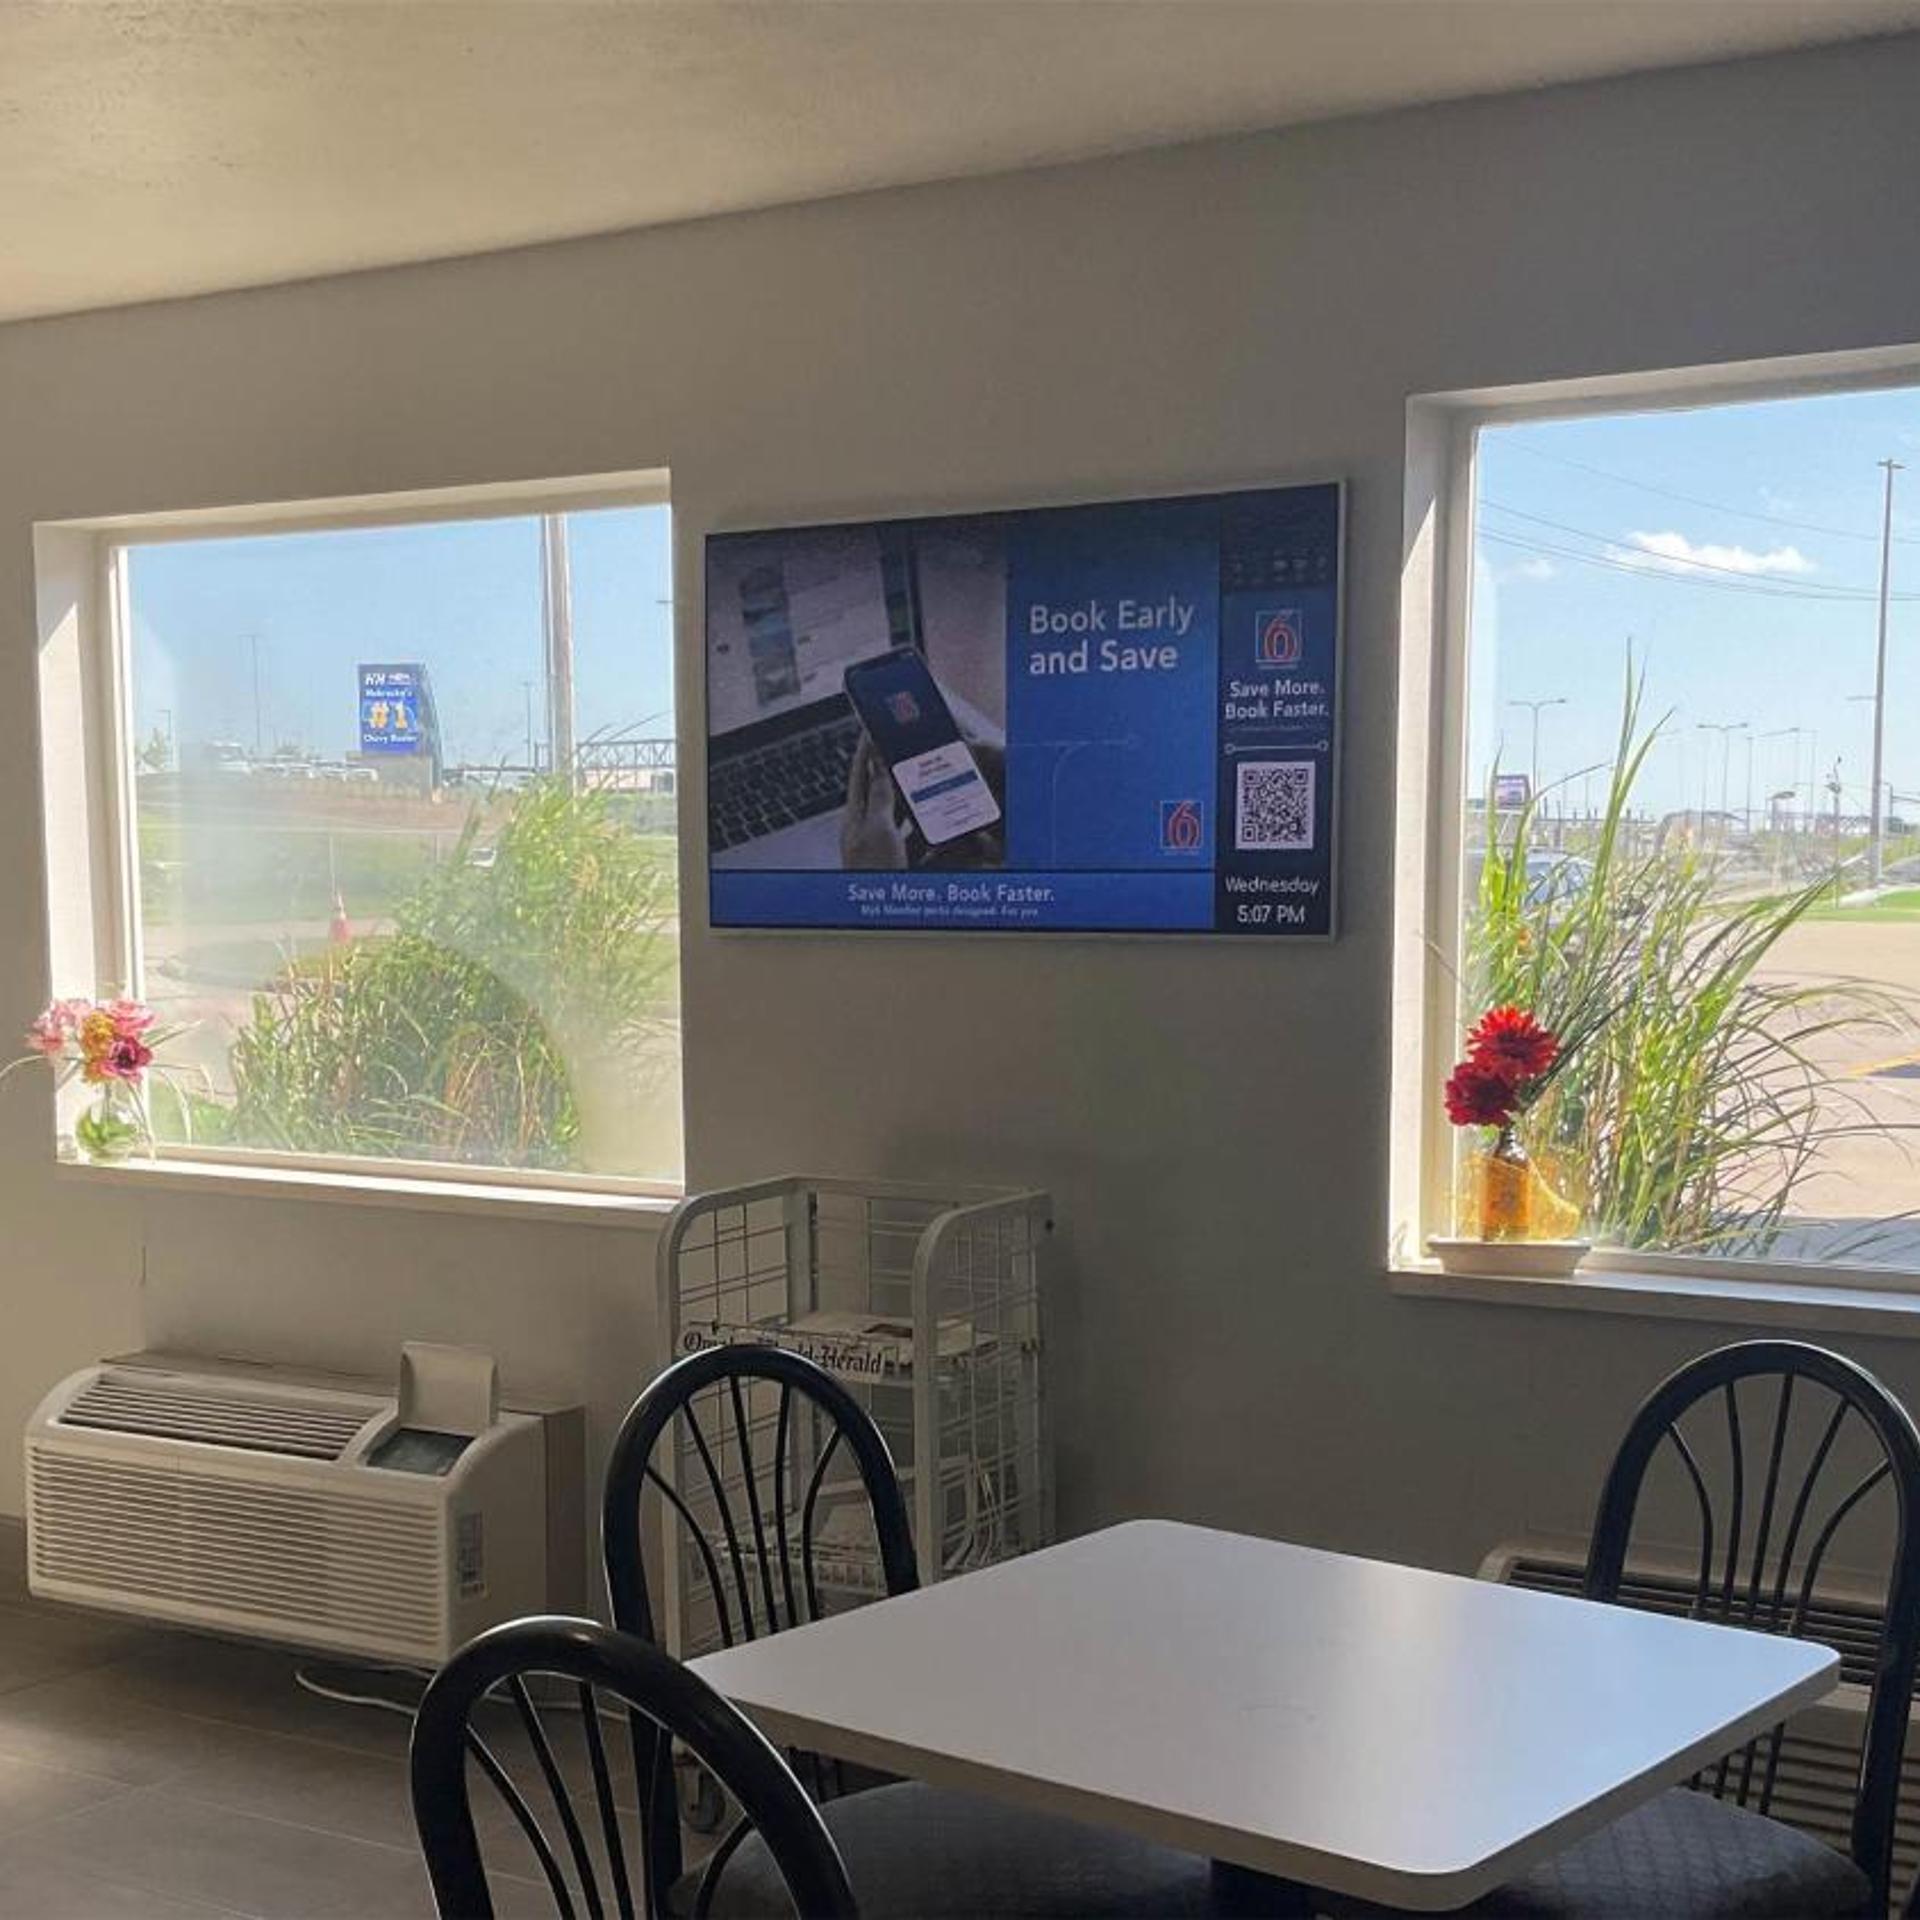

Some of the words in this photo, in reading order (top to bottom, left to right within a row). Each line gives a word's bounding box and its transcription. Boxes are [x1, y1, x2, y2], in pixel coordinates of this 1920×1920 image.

[1030, 599, 1106, 634] Book
[1117, 595, 1194, 636] Early
[1029, 638, 1089, 675] and
[1100, 639, 1178, 672] Save
[1229, 681, 1269, 698] Save
[1274, 679, 1326, 696] More.
[369, 700, 408, 730] #1
[1225, 699, 1268, 719] Book
[1273, 700, 1330, 718] Faster.
[848, 884, 886, 902] Save
[891, 882, 942, 902] More.
[948, 883, 992, 901] Book
[998, 884, 1055, 902] Faster.
[1225, 875, 1320, 897] Wednesday
[1237, 904, 1271, 924] 5:07
[1276, 904, 1306, 925] PM
